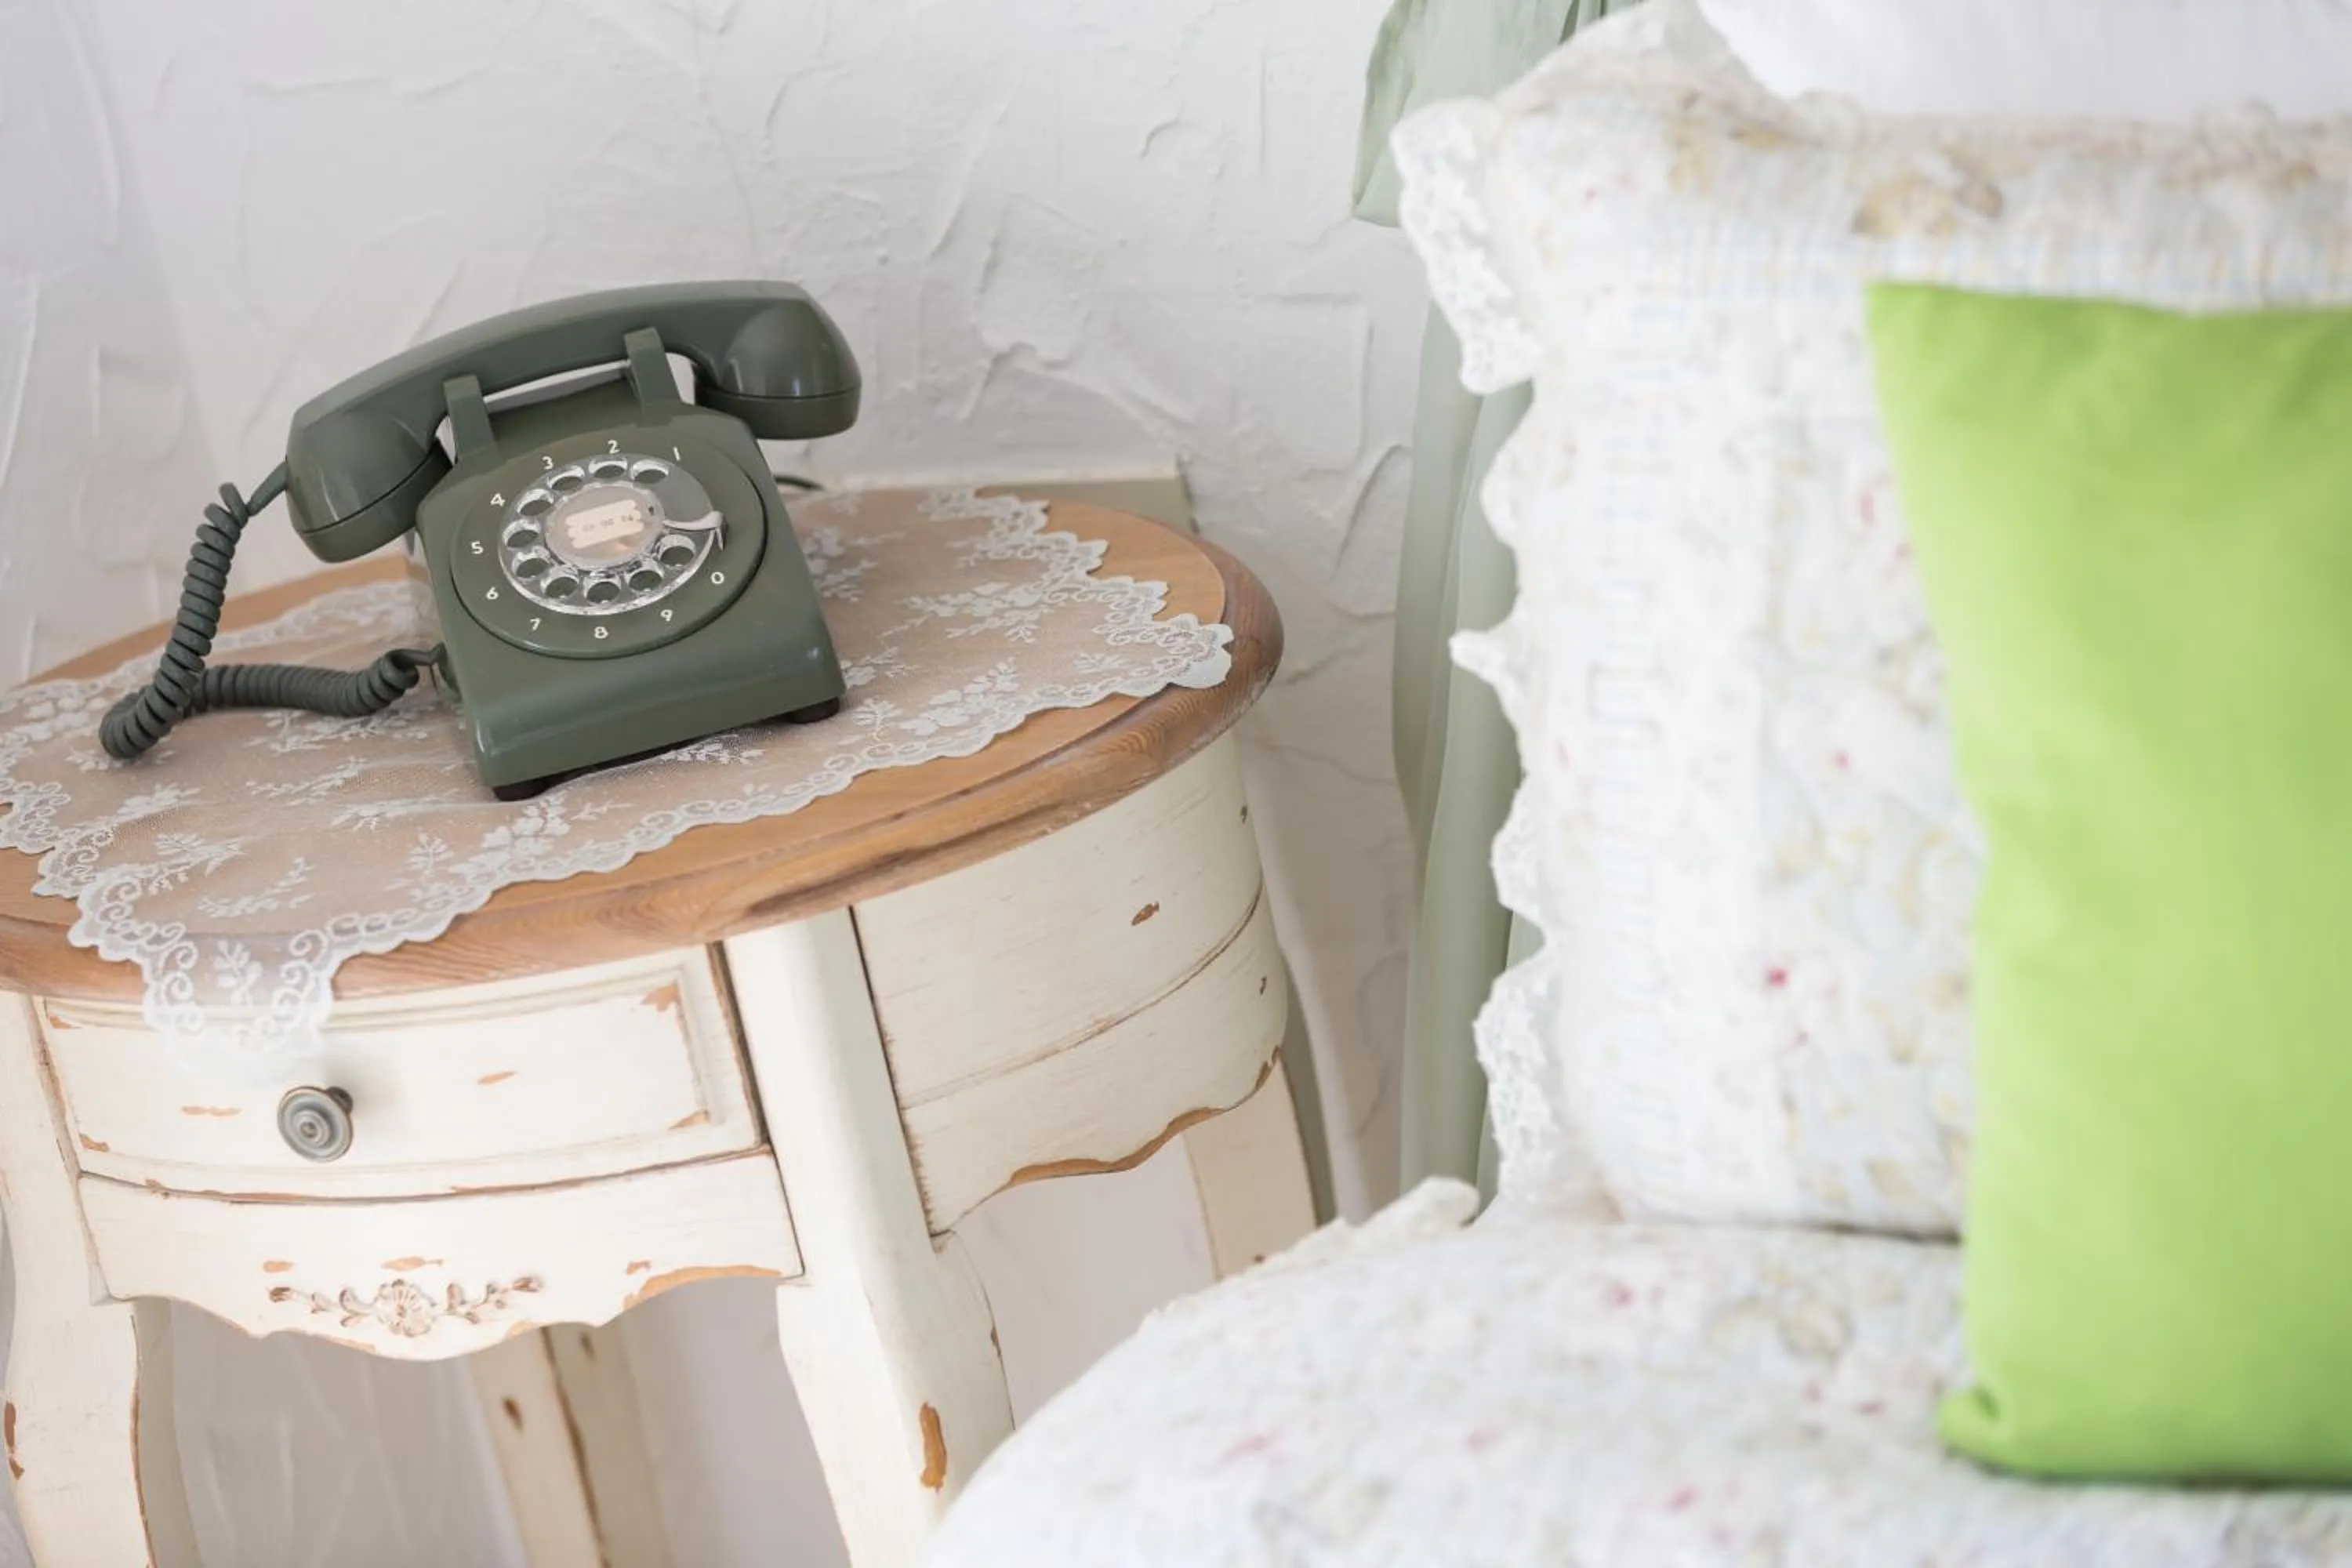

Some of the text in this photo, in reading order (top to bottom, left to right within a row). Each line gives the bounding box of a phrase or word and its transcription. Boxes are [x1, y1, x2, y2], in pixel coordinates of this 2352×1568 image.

[608, 440, 619, 454] 2
[673, 447, 680, 460] 1
[543, 456, 554, 470] 3
[491, 493, 505, 506] 4
[471, 541, 483, 554] 5
[711, 572, 724, 584] 0
[486, 587, 499, 599] 6
[661, 610, 672, 621] 9
[530, 618, 540, 630] 7
[594, 626, 608, 638] 8
